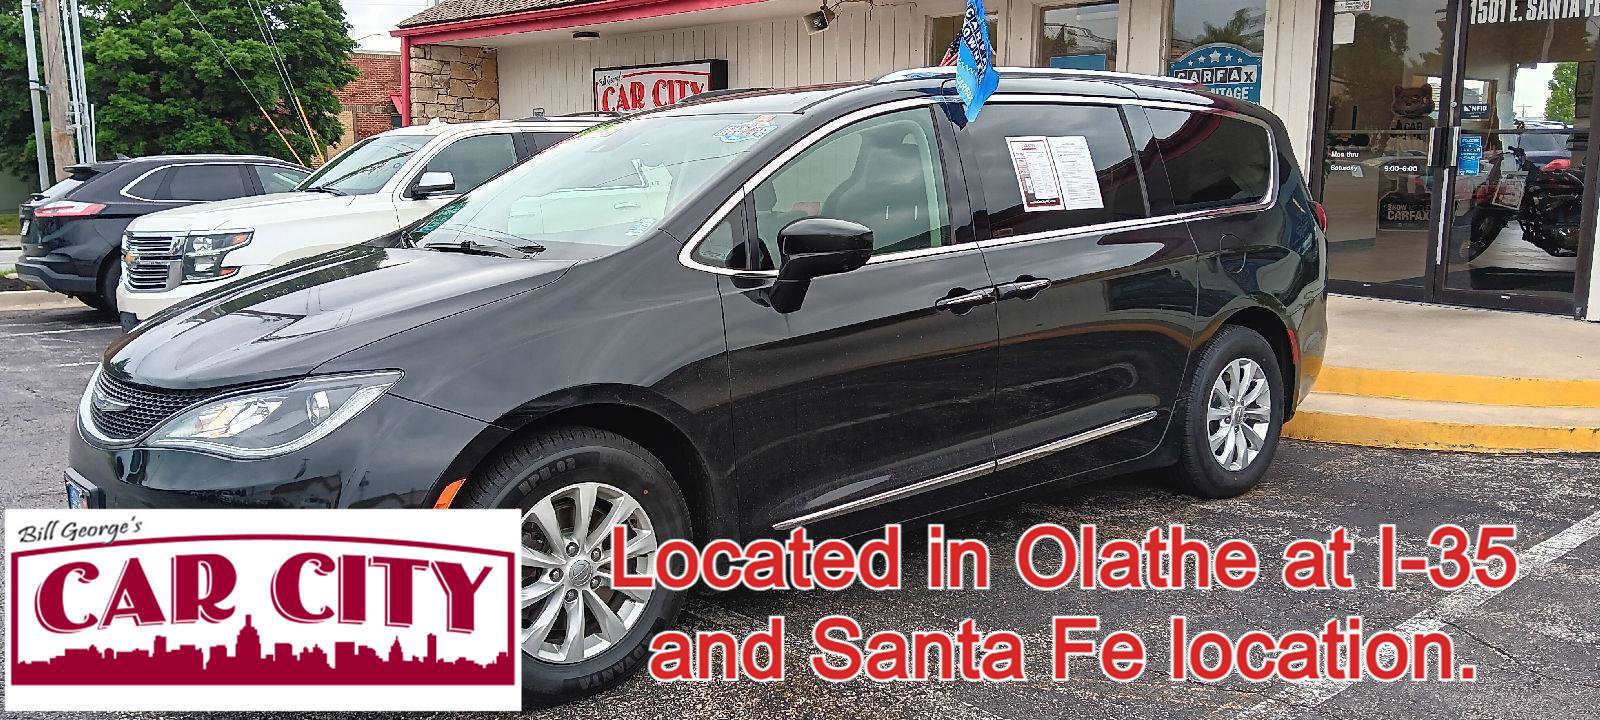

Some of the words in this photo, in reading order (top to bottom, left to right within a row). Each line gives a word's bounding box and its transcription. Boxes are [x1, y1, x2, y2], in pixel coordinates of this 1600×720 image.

[1470, 0, 1506, 24] 1501
[1509, 0, 1523, 21] E.
[1526, 0, 1580, 20] SANTA
[1177, 69, 1254, 83] CARFAX
[602, 81, 645, 111] CAR
[652, 79, 705, 107] CITY
[1330, 165, 1358, 173] Saturday
[1387, 210, 1431, 221] CARFAX
